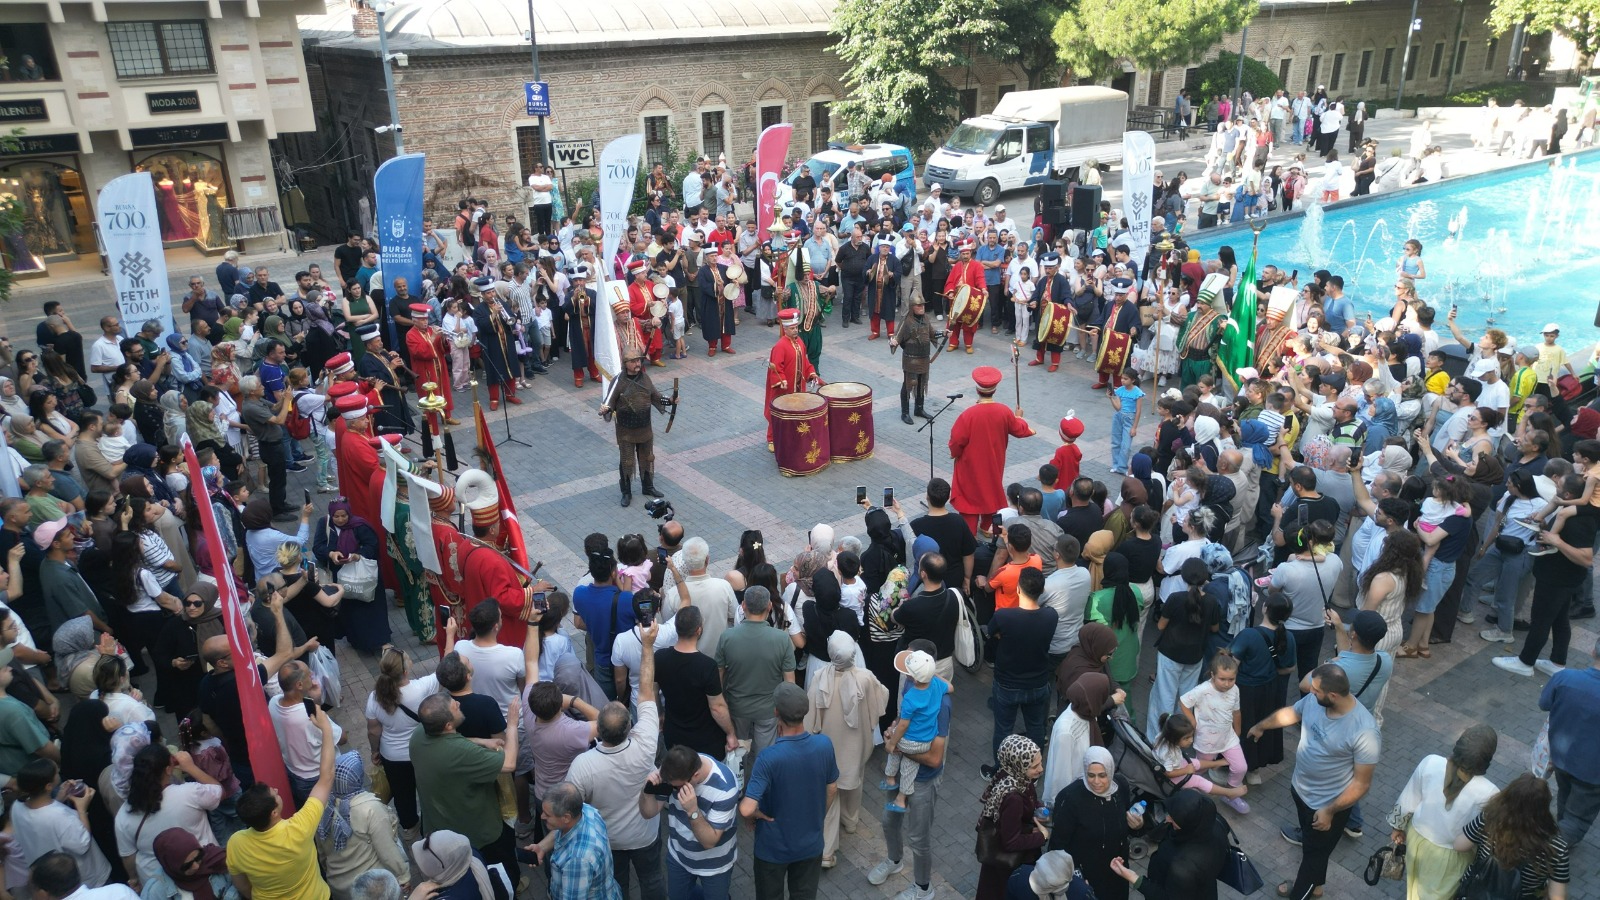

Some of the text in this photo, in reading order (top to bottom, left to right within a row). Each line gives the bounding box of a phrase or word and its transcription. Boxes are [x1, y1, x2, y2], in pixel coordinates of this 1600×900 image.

[151, 97, 197, 107] MODA 2000
[0, 105, 44, 116] İLENLER
[557, 149, 590, 161] WC
[606, 164, 635, 179] 700
[104, 211, 146, 230] 700
[120, 289, 159, 301] FETİH
